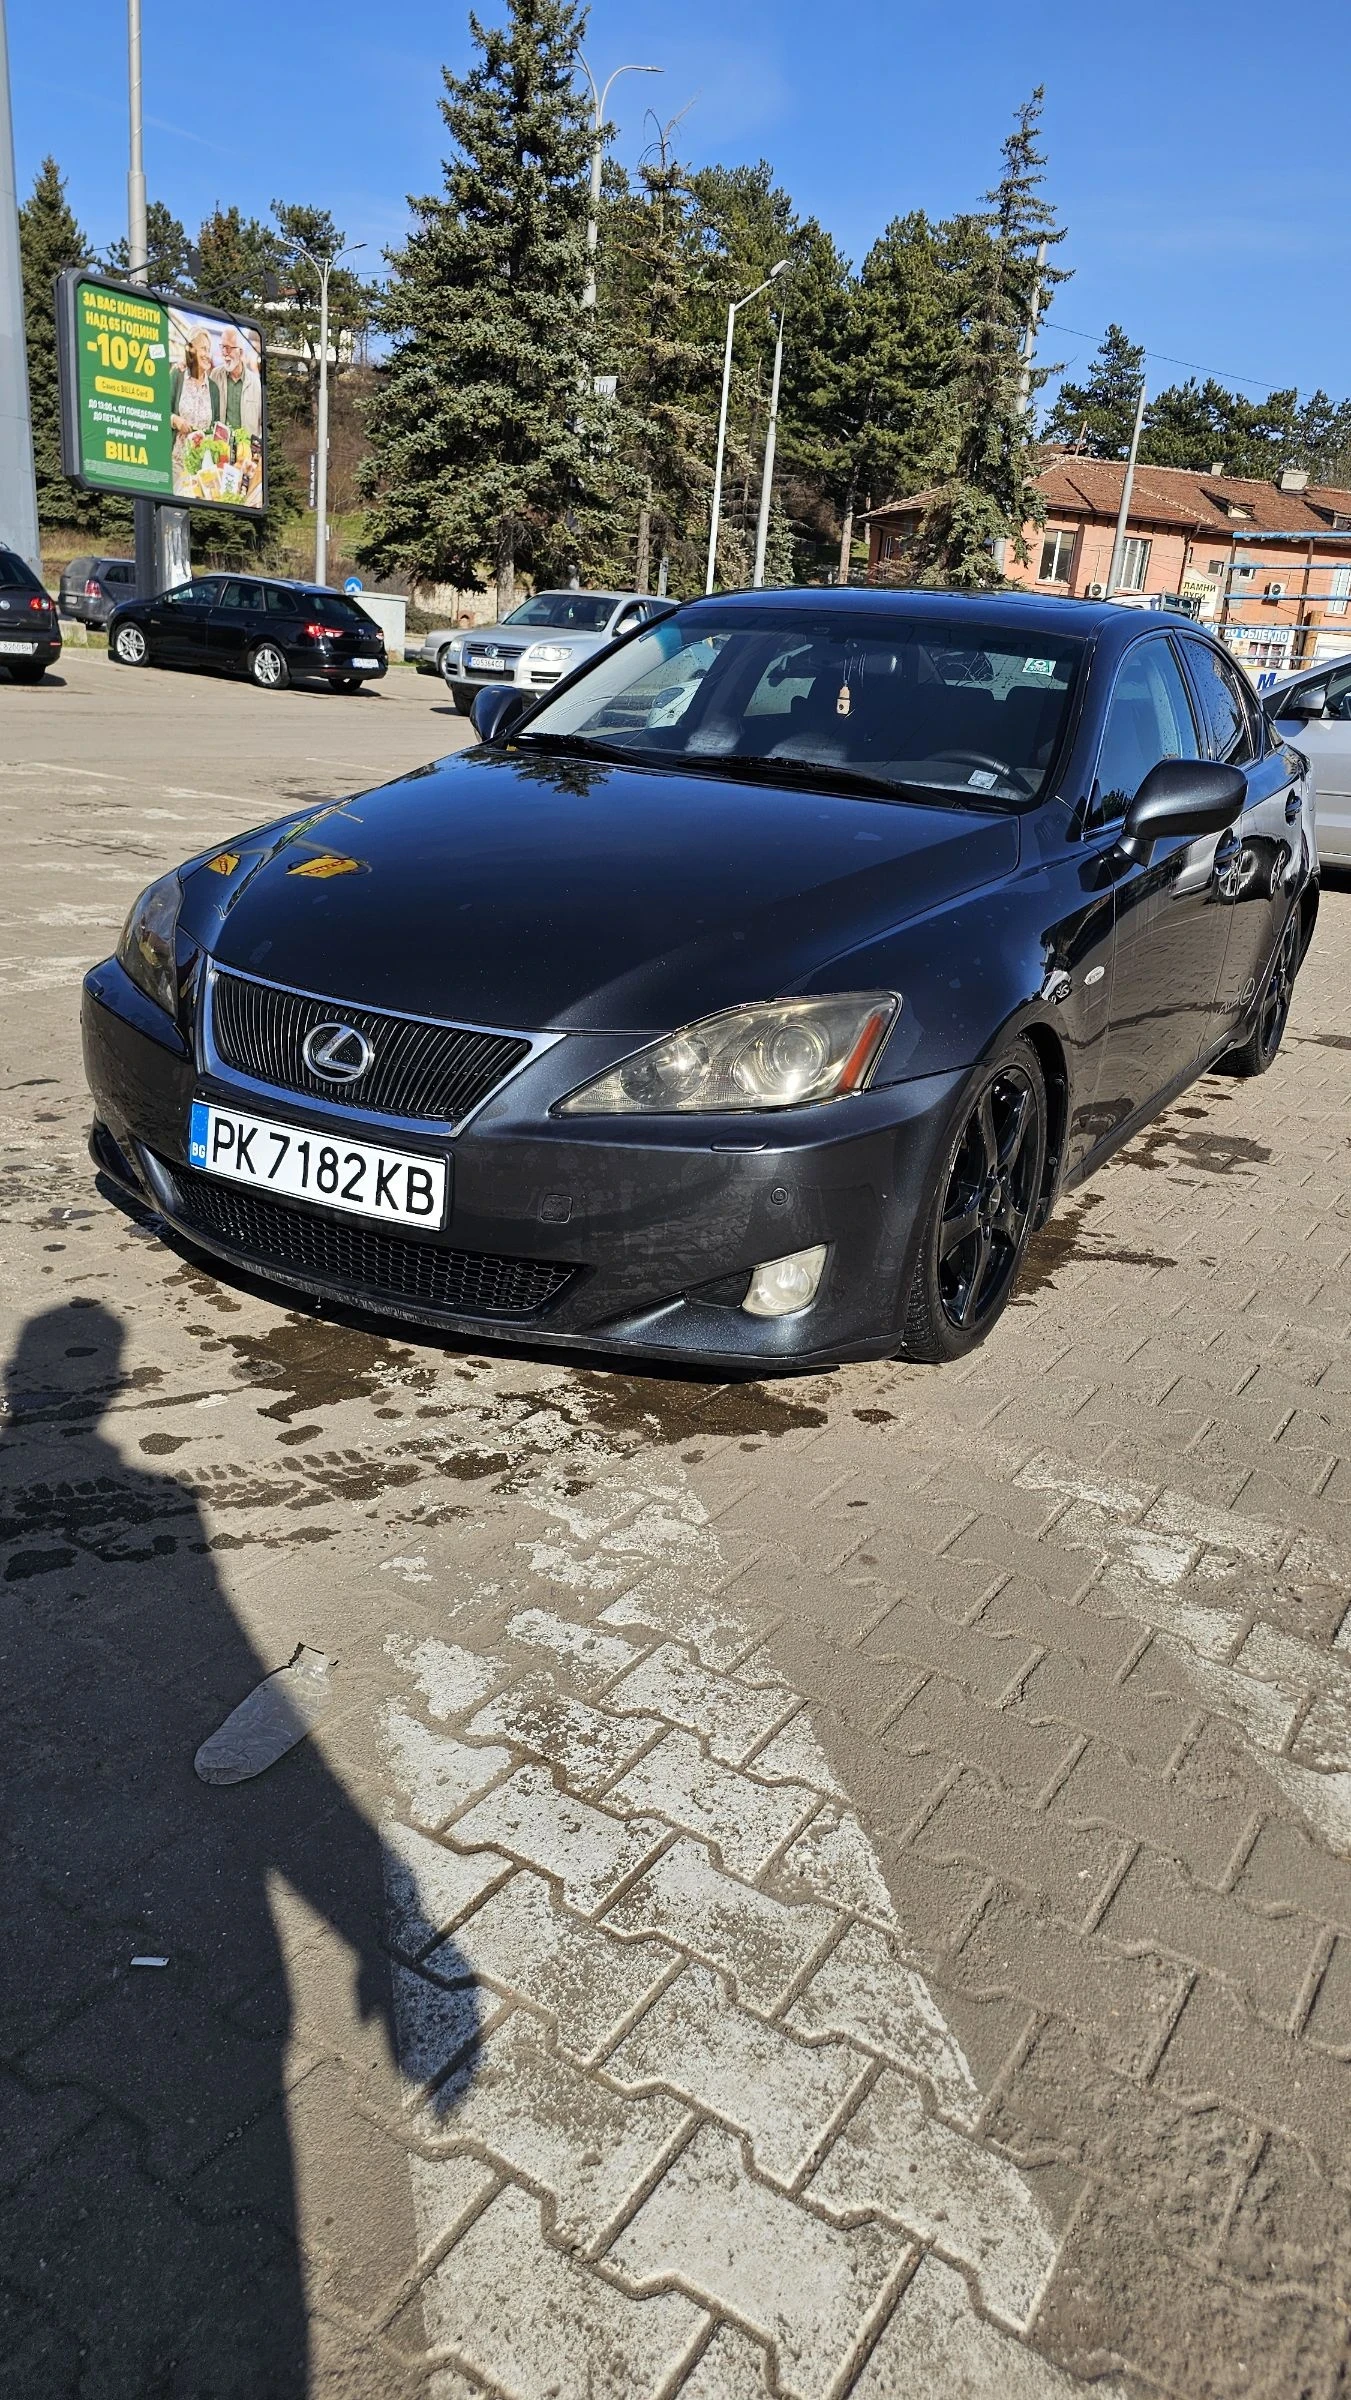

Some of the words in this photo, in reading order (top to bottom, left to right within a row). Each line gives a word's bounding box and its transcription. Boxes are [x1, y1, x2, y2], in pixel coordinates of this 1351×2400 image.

[83, 291, 96, 307] ЗА
[97, 295, 116, 313] ВАС
[117, 301, 160, 324] КЛИЕНТИ
[86, 311, 108, 331] НАД
[108, 317, 120, 331] 65
[121, 320, 159, 342] ГОДИНИ
[87, 333, 156, 376] -10%
[105, 440, 148, 465] BILLA
[1241, 628, 1289, 642] ОБЛЕКЛО
[191, 1142, 206, 1158] BG
[212, 1117, 258, 1174] PK
[268, 1132, 367, 1203] 7182
[375, 1159, 434, 1216] KB
